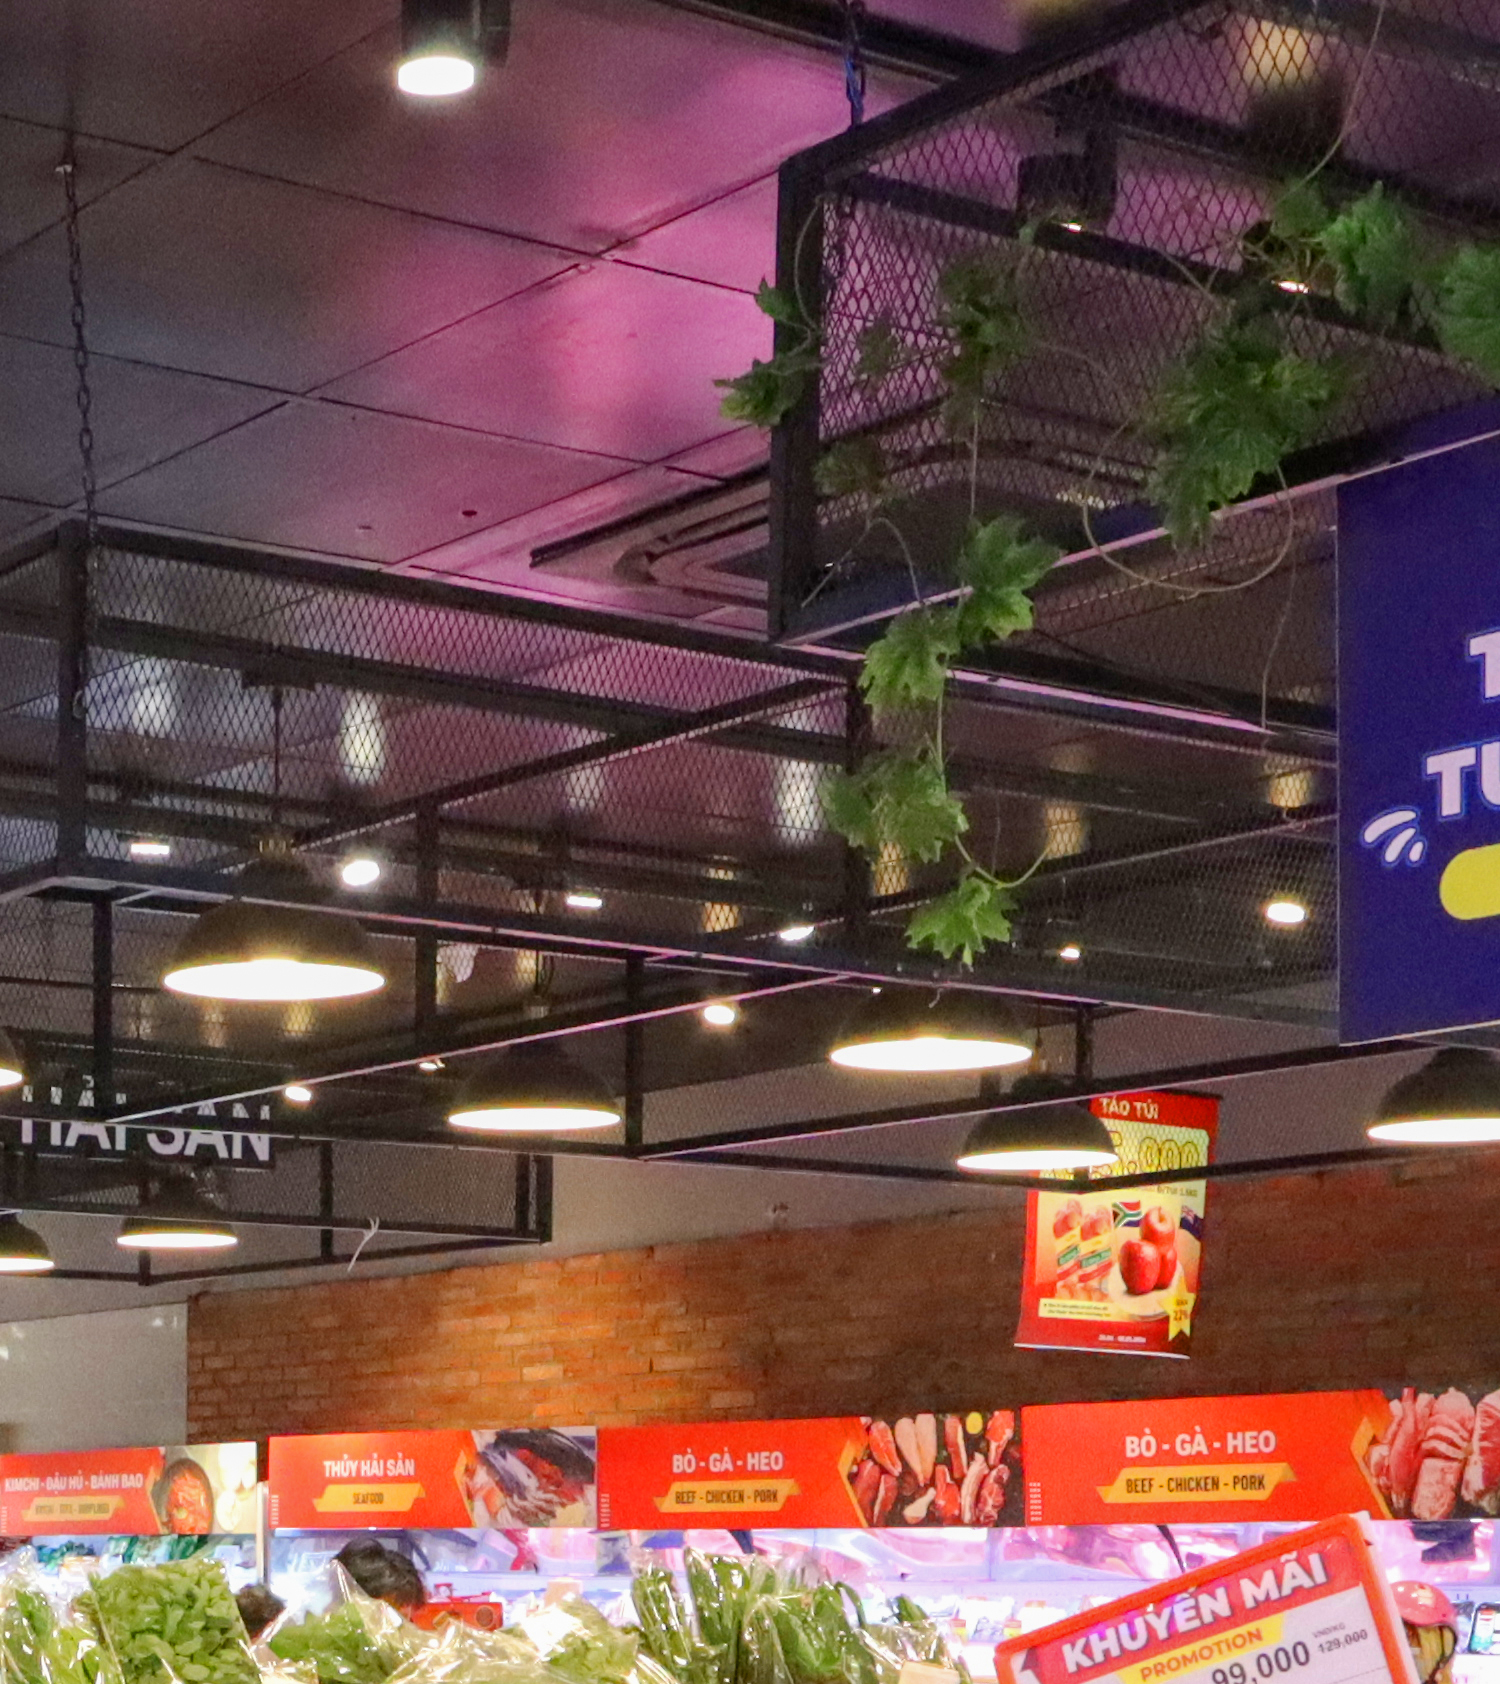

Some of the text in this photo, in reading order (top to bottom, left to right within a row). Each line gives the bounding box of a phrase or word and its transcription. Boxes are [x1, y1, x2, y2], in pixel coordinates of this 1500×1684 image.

[1125, 1425, 1277, 1458] BÒ GÀ HEO
[323, 1452, 416, 1478] THỦY HẢI SẢN
[672, 1446, 784, 1474] BÒ GÀ HEO
[4, 1473, 144, 1492] KIMCHI BAO
[1126, 1474, 1266, 1494] BEEF CHICKEN PORK
[675, 1489, 778, 1504] BEEF CHICKEN PORK
[1062, 1549, 1329, 1676] KHUYẾN MÃI
[1139, 1627, 1264, 1683] PROMOTION
